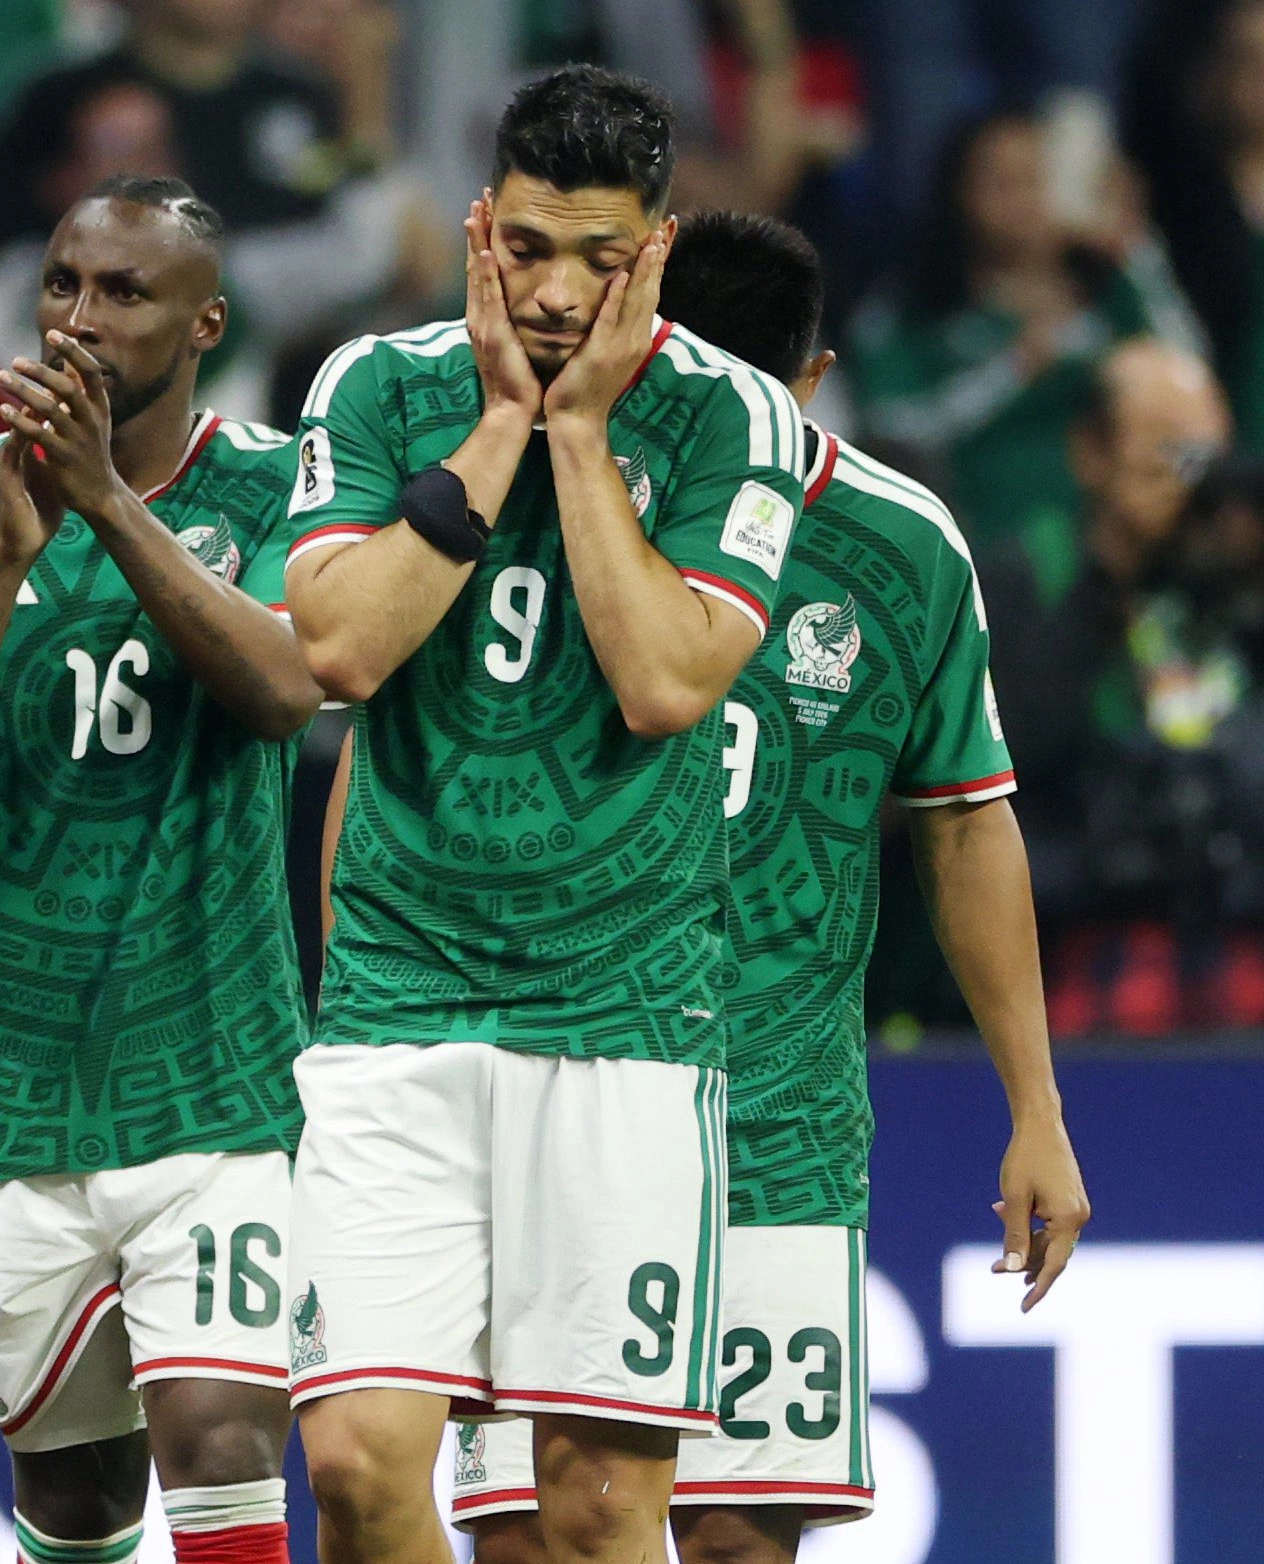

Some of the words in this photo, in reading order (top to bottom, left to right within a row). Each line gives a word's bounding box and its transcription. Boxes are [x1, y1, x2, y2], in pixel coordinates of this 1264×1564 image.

[736, 530, 777, 558] EDUCATION
[485, 567, 546, 682] 9
[787, 668, 848, 690] MÉXICO
[67, 639, 151, 760] 16
[722, 702, 759, 819] 3
[188, 1222, 282, 1328] 16
[622, 1263, 679, 1377] 9
[719, 1326, 842, 1440] 23
